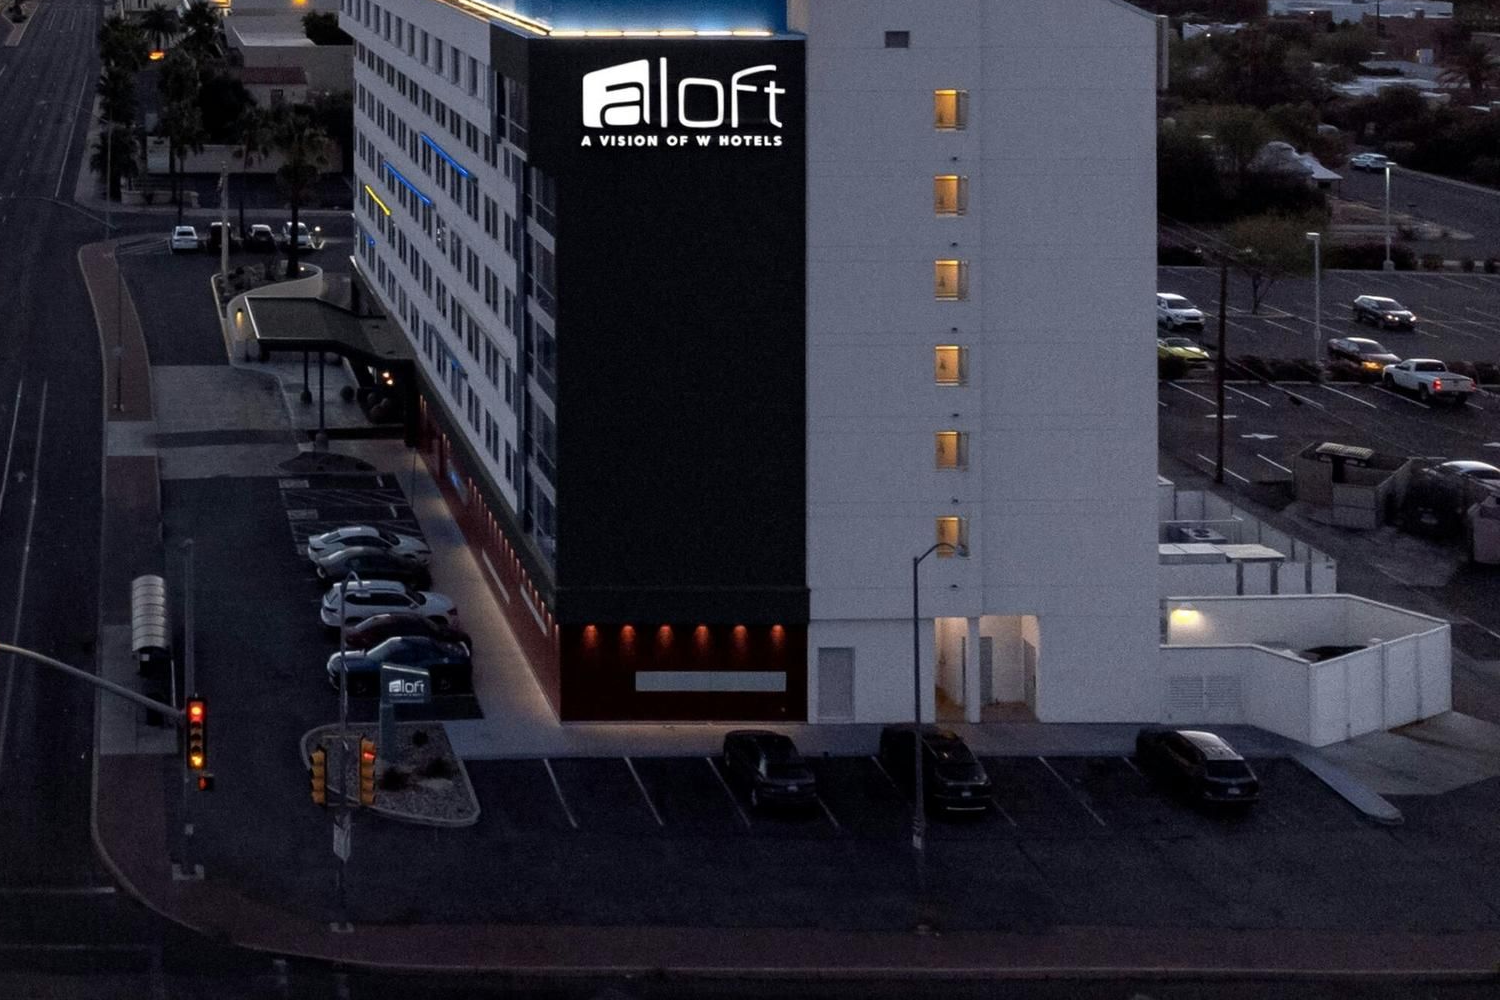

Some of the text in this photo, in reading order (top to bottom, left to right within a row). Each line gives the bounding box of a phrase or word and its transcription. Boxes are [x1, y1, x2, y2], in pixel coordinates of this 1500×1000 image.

[583, 57, 785, 128] aloft
[581, 135, 783, 146] A VISION OF W HOTELS
[388, 679, 425, 693] aloft
